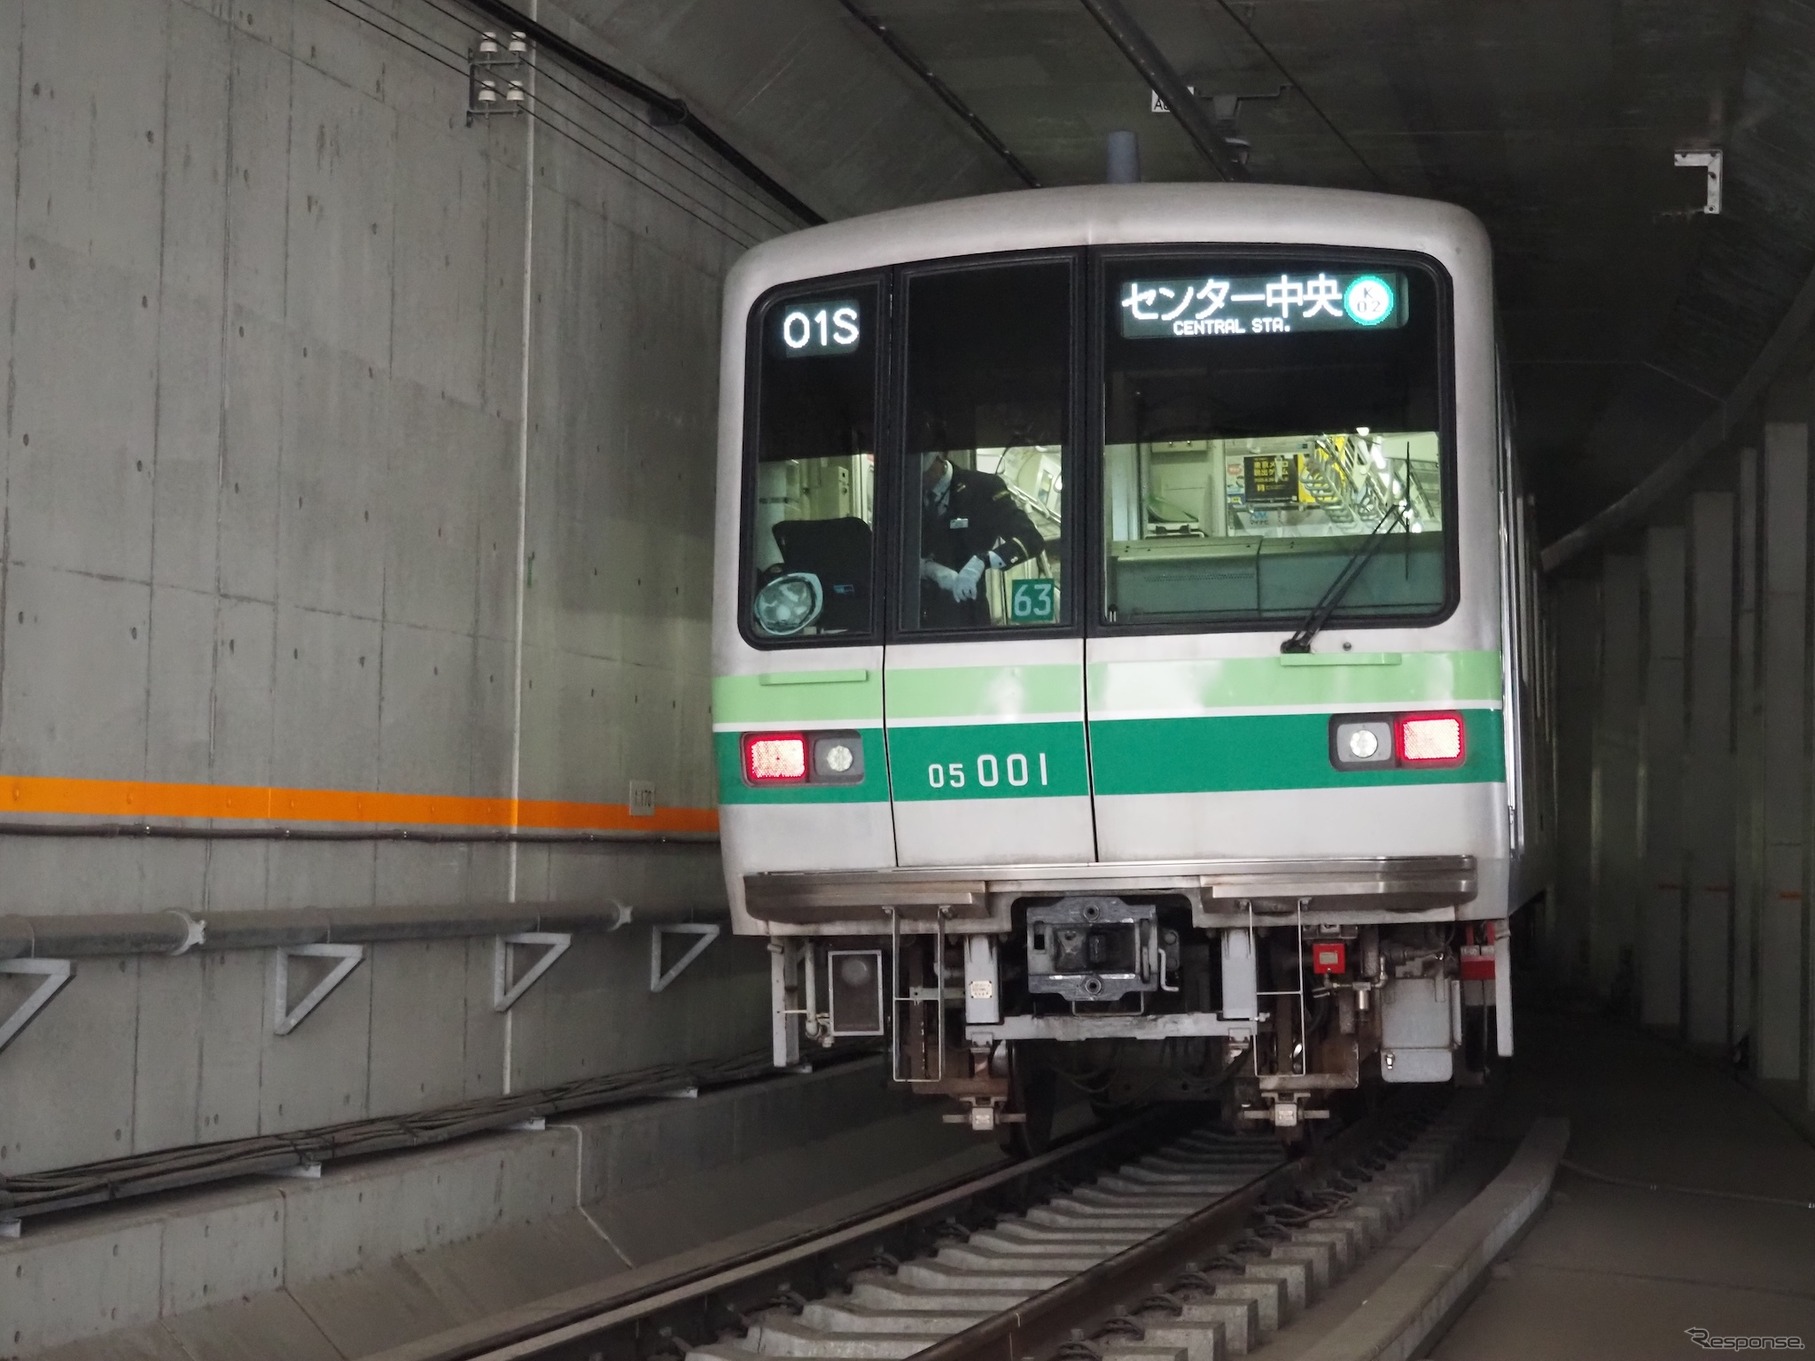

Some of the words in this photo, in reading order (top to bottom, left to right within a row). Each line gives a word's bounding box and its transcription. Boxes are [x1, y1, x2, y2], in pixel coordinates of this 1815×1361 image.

[1121, 273, 1344, 320] センター中央
[1363, 287, 1374, 299] K
[783, 307, 860, 349] 01S
[1172, 319, 1246, 336] CENTRAL
[1251, 317, 1291, 333] STA.
[1013, 583, 1052, 617] 63
